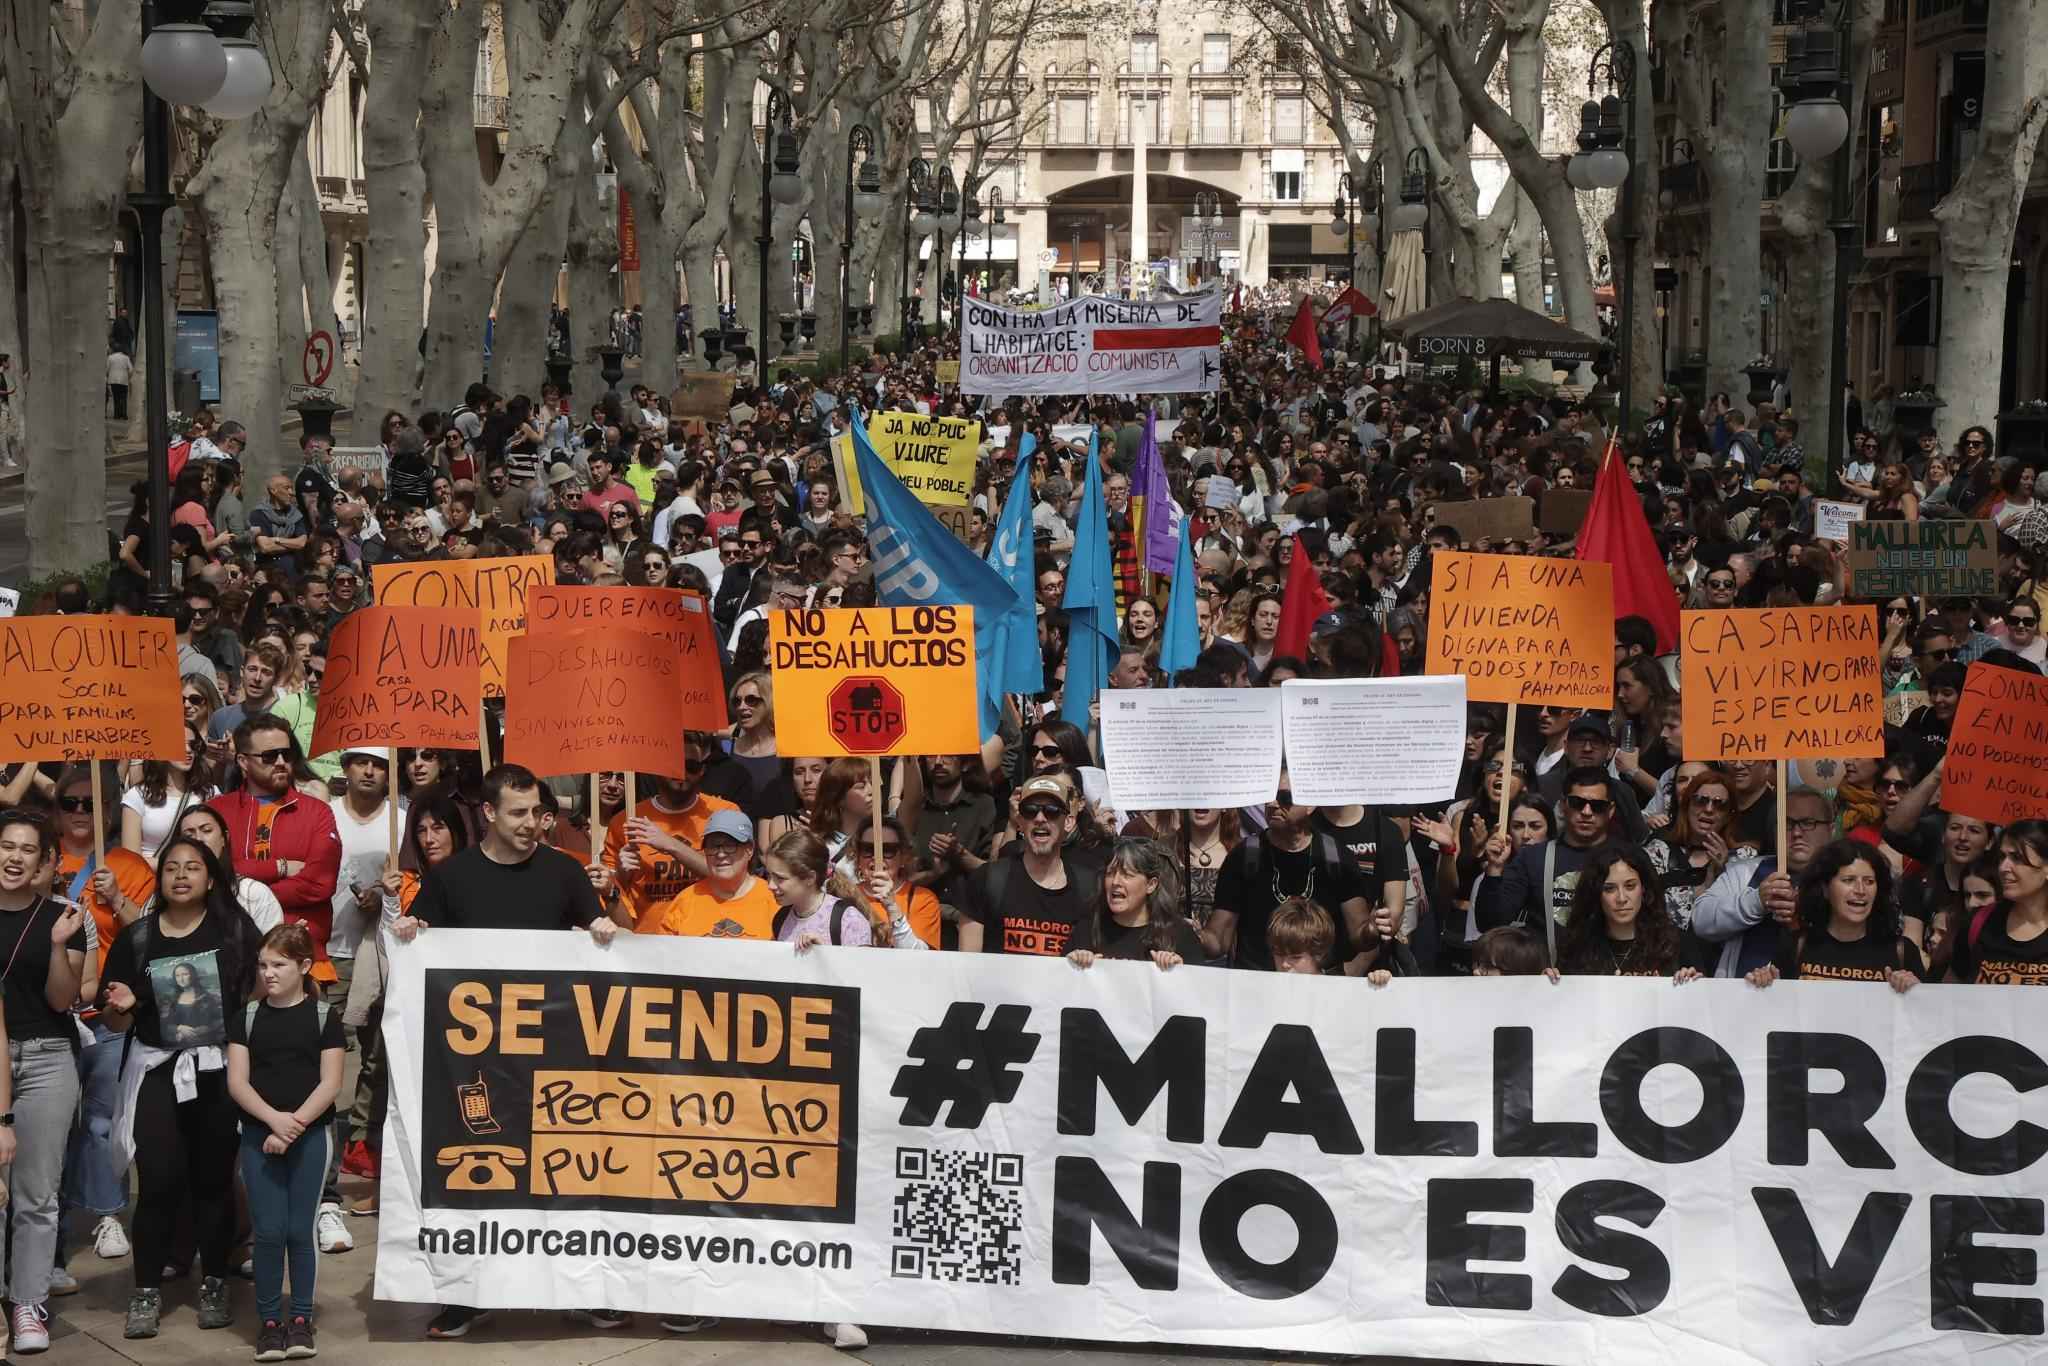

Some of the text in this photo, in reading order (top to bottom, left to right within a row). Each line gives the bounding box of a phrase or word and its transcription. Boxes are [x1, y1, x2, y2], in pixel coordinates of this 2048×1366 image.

[968, 306, 1046, 328] CONTRA
[1055, 303, 1077, 326] LA
[1177, 302, 1202, 322] DE
[1419, 338, 1486, 354] BORN 8
[1545, 350, 1591, 359] restaurant
[1088, 352, 1181, 372] COMUNISTA
[885, 419, 966, 439] JA NO PUC
[894, 442, 949, 465] VIURE
[1855, 522, 1988, 550] MALLORCA
[1876, 550, 1968, 568] NO ES UN
[1491, 560, 1510, 590] A
[1529, 564, 1585, 588] UNA
[536, 595, 685, 622] QUEREMOS
[785, 606, 957, 637] NO A LOS
[1442, 602, 1561, 632] VIVIENDA
[3, 620, 178, 679] ALQUILER
[376, 615, 407, 675] A
[419, 623, 480, 670] UNA
[775, 637, 967, 670] DESAHUCIOS
[528, 645, 674, 686] DESAHUCIOS
[1452, 658, 1600, 680] TODOS Y TODAS
[58, 677, 128, 699] SOCIAL
[375, 675, 413, 688] CASA
[577, 677, 628, 709] NO
[0, 702, 137, 723] PARA FAMILIAS
[316, 686, 469, 729] DIGNA PARA
[1712, 693, 1875, 725] ESPECULAR
[832, 710, 902, 734] STOP
[1971, 707, 2014, 736] EN
[14, 726, 153, 749] VULNERABRES
[1721, 725, 1885, 757] PAH MALLORCA
[1950, 742, 1977, 758] NO
[63, 748, 97, 762] PAH
[1948, 767, 1973, 785] UN
[1007, 931, 1037, 949] NO
[1801, 962, 1886, 981] MALLORCA
[445, 981, 832, 1070] SE VENDE
[536, 1077, 828, 1136] Però no ho
[658, 1144, 812, 1202] pagar
[418, 1220, 852, 1271] mallorcanoesven.com
[1052, 1155, 2046, 1336] NO ES VE
